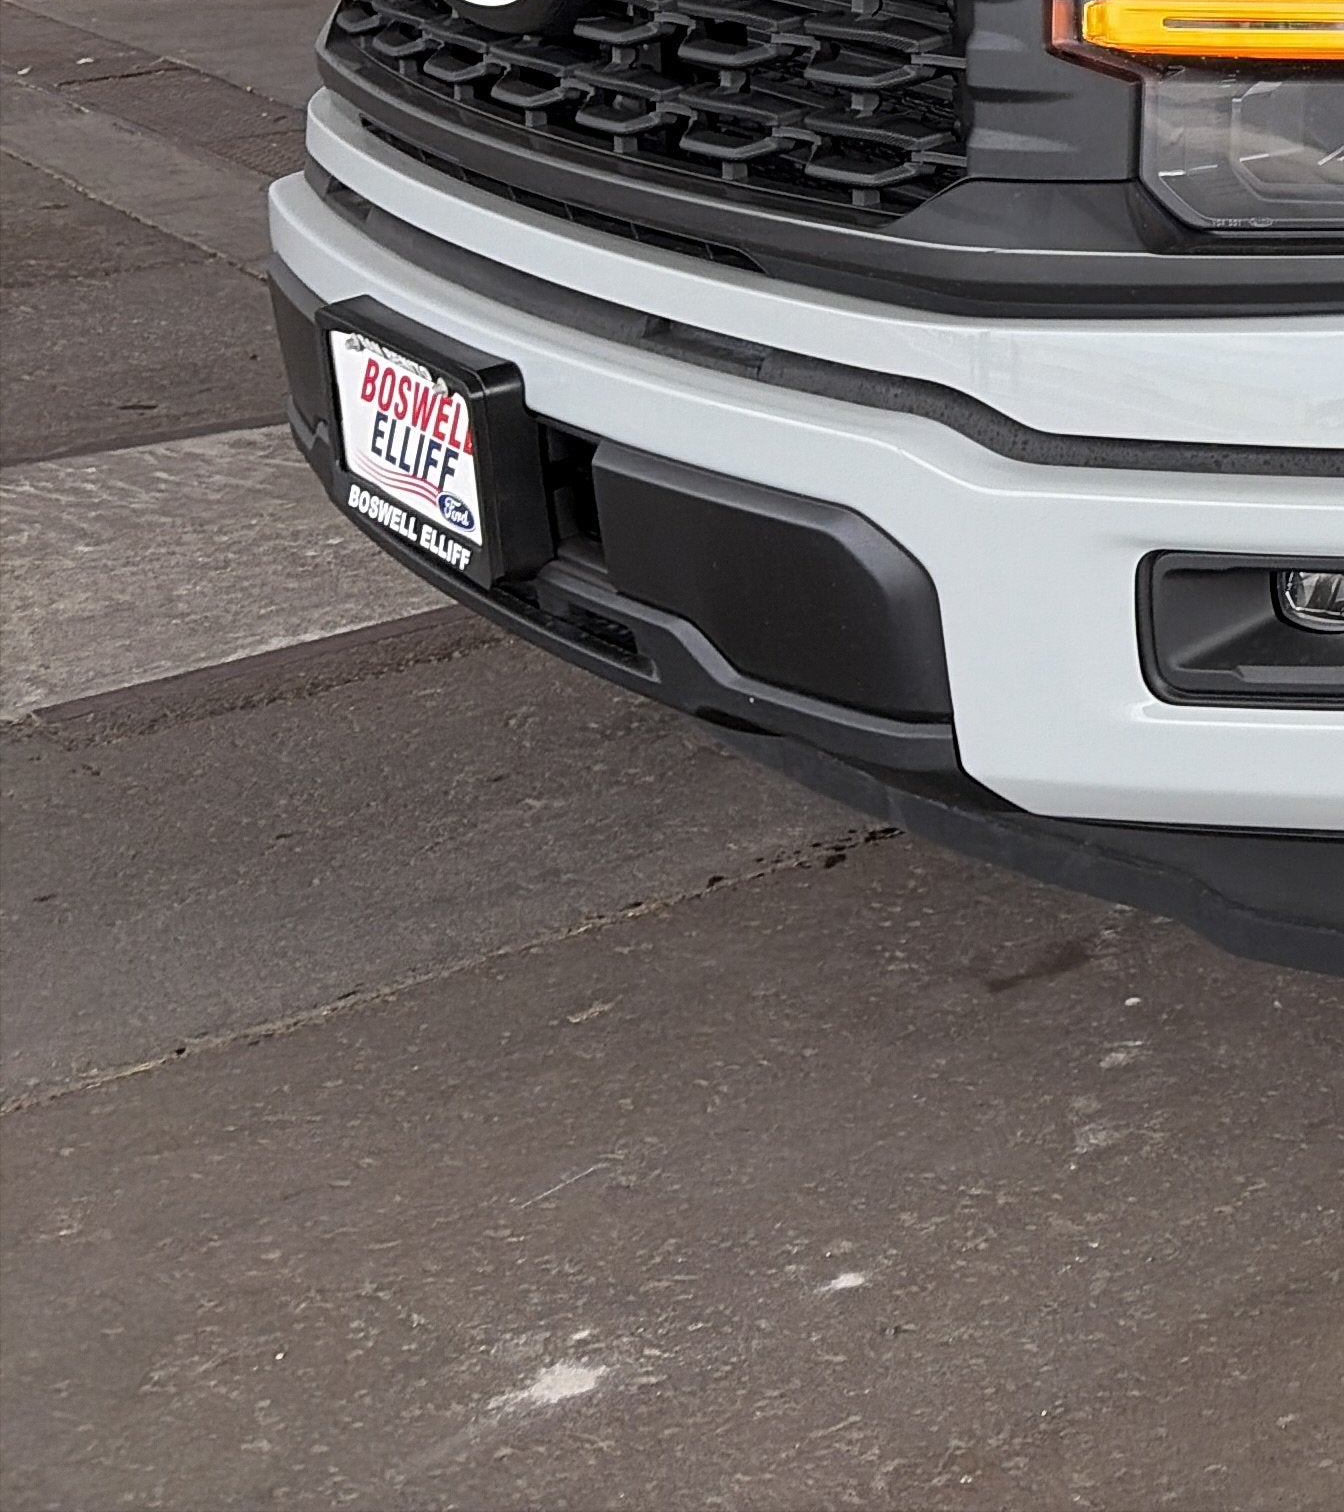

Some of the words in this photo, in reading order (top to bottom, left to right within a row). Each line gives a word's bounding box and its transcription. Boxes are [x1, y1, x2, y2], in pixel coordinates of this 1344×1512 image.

[371, 411, 460, 492] ELLIFF
[348, 484, 418, 542] BOSWELL
[420, 524, 471, 571] ELLIFF
[444, 496, 470, 527] Ford
